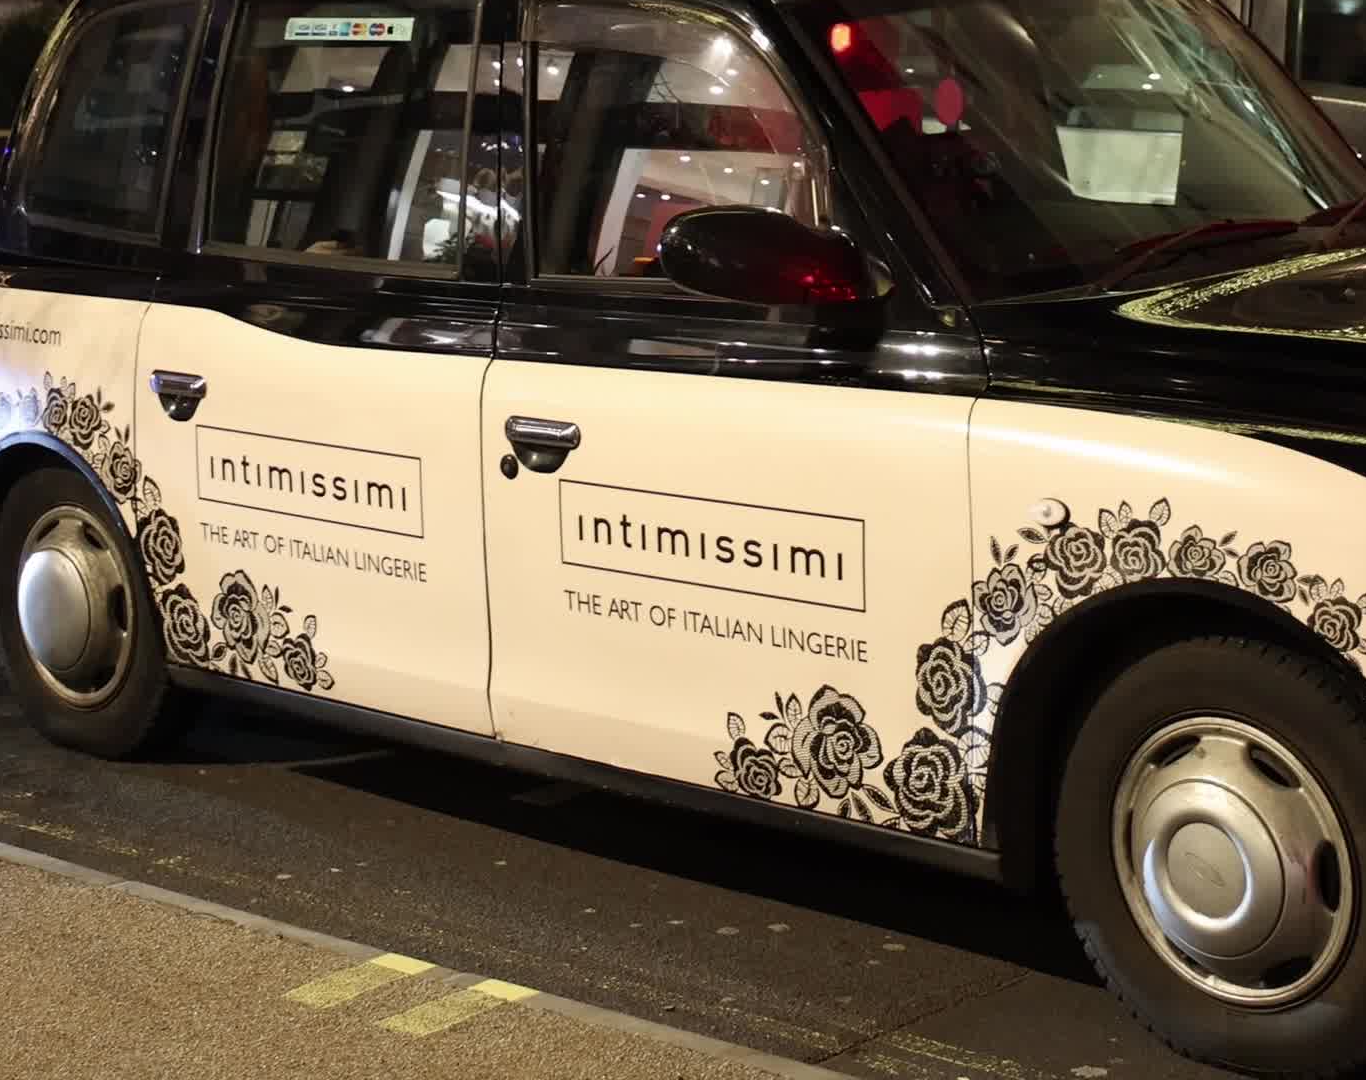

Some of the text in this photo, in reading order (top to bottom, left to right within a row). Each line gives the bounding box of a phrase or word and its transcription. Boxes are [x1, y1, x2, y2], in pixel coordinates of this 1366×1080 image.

[210, 455, 407, 512] intimissimi
[200, 522, 428, 583] THE ART OF ITALIAN LINGERIE
[578, 513, 844, 581] intimissimi
[564, 589, 869, 663] THE ART OF ITALIAN LINGERIE
